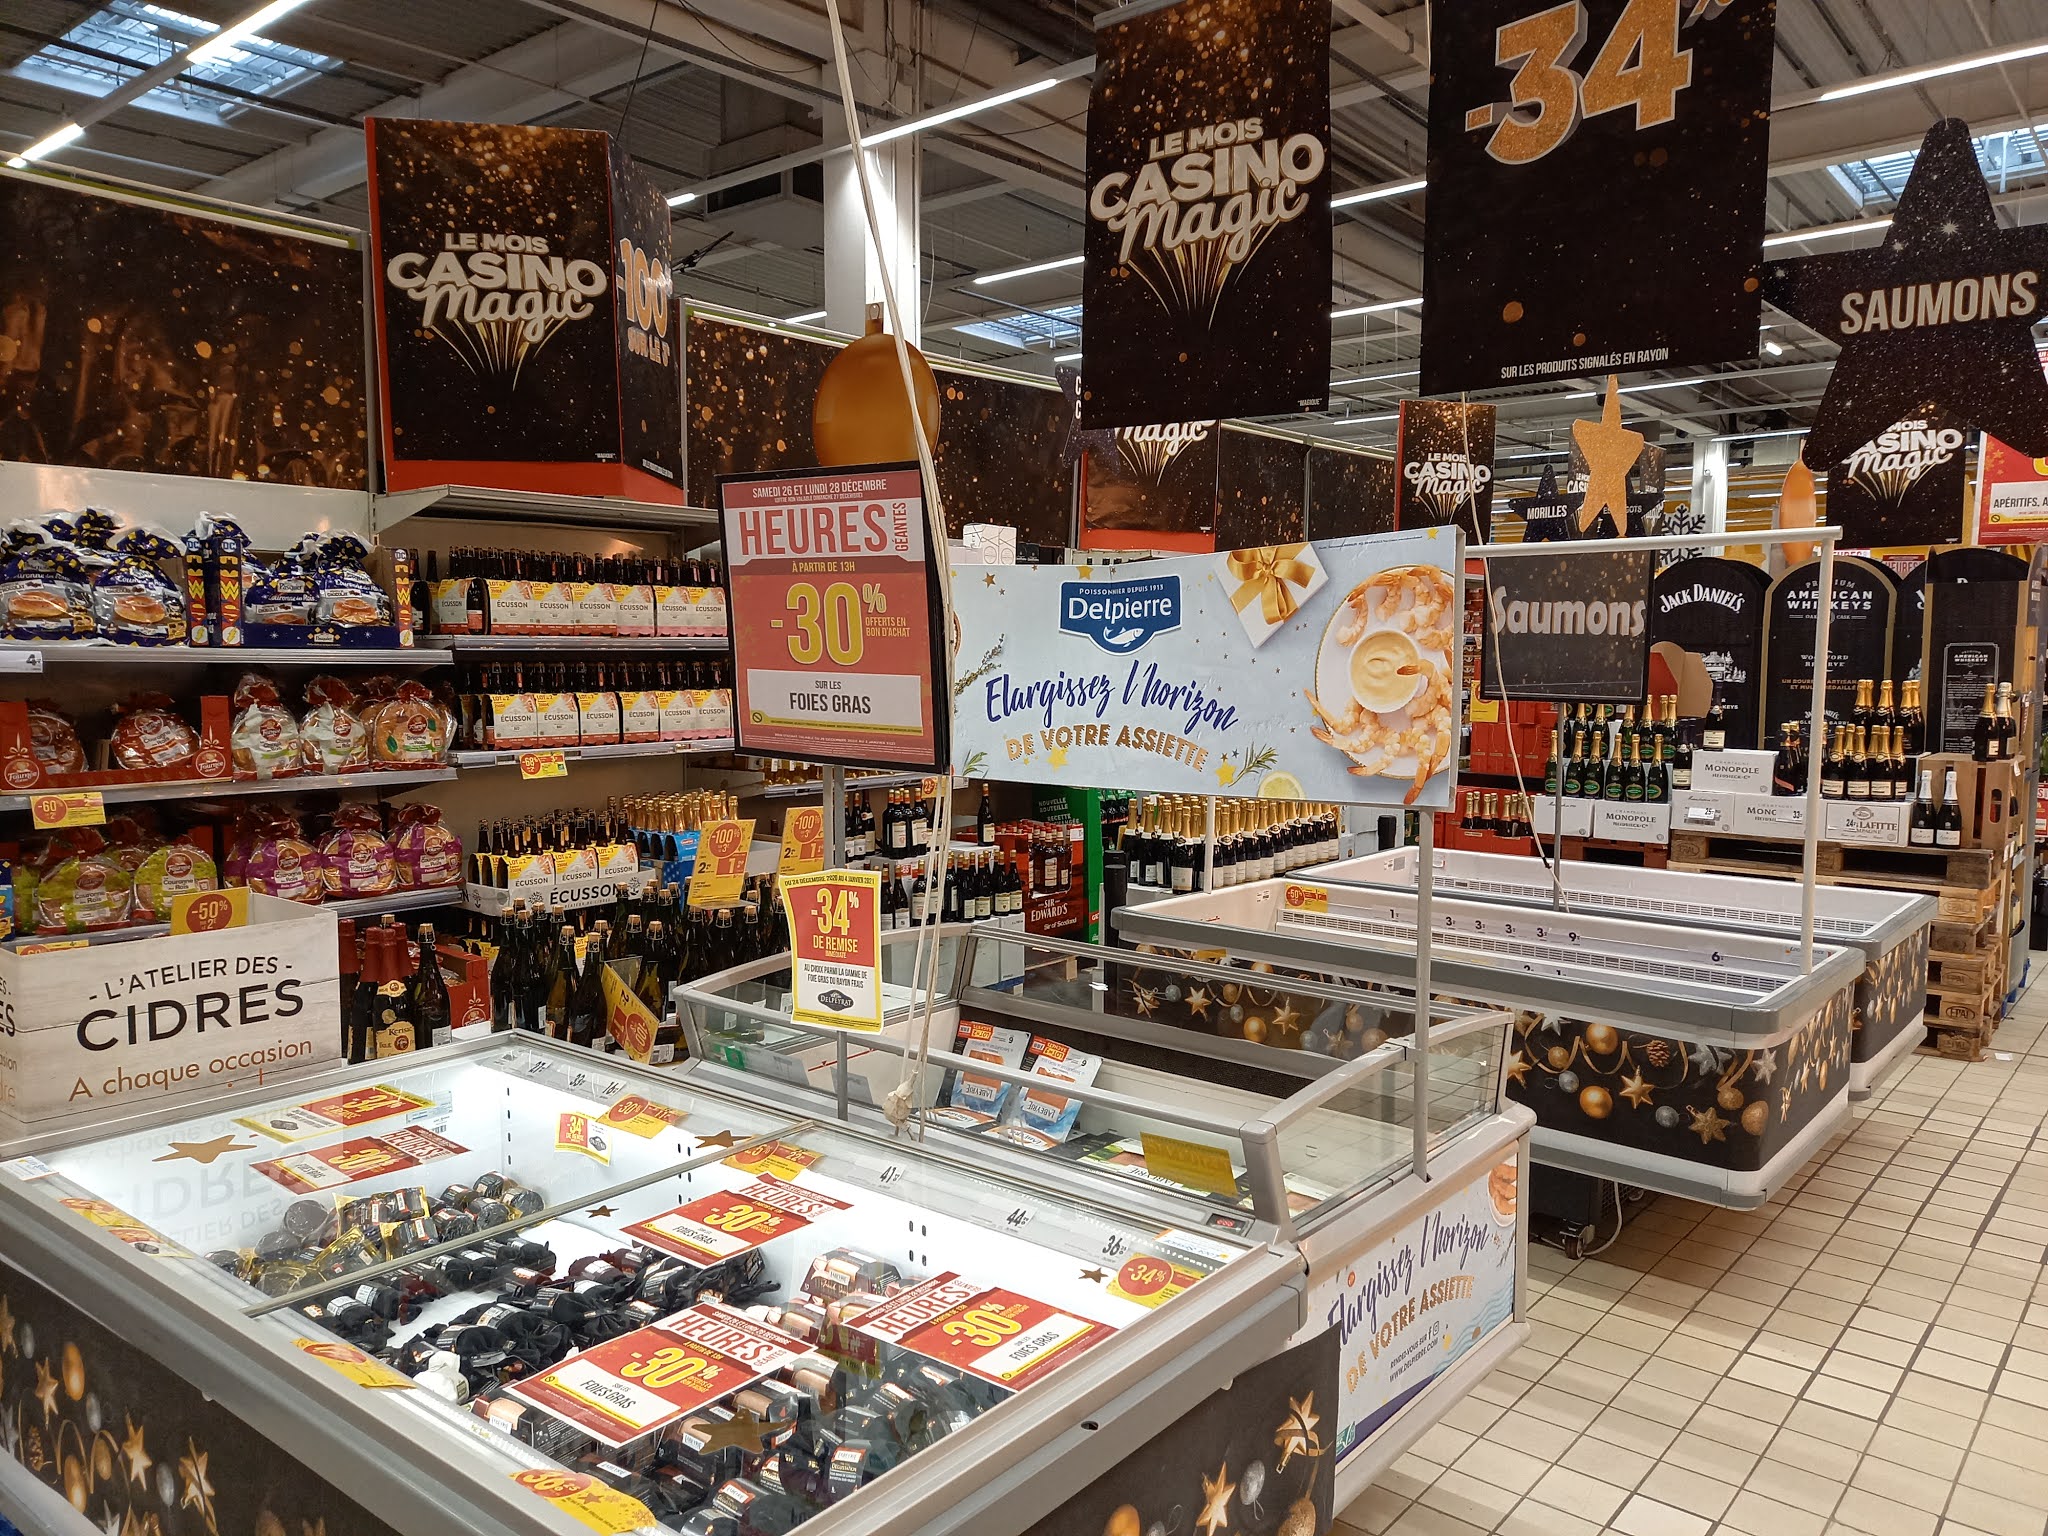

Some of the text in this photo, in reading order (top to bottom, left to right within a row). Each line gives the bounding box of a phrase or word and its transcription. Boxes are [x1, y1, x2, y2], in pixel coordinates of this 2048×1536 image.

[1149, 117, 1264, 160] LE MOIS
[1090, 133, 1326, 220] CASINO
[444, 233, 549, 254] LE MOIS
[387, 252, 607, 297] CASINO
[1840, 271, 2037, 335] SAUMONS
[1501, 347, 1669, 379] SUR LES PRODUITS SIGNALÉS EN RAYON
[1427, 453, 1441, 462] LE
[752, 479, 887, 498] SAMEDI 26 ET LUNDI 28 DÉCEMBRE
[1526, 504, 1568, 520] MORILLES
[739, 503, 888, 557] HEURES
[892, 502, 909, 552] GÉANTES
[792, 561, 855, 573] À PARTIR DE 13H
[1079, 583, 1164, 596] POISSONNIER DEPUIS 1913
[1659, 584, 1746, 614] JACK DANIEL'S
[1787, 590, 1873, 600] AMEICAN
[496, 599, 528, 608] ÉCUSSON
[539, 602, 569, 610] ÉCUSSON
[579, 601, 611, 610] ÉCUSSON
[619, 603, 649, 611] ÉCUSSON
[1068, 597, 1172, 624] Delpierre
[1492, 585, 1645, 637] Saumons
[1787, 601, 1872, 610] WHIKEYS
[770, 581, 888, 667] -30%
[865, 616, 907, 627] OFFERTS EN
[866, 627, 910, 638] BON D'ACHAT
[815, 680, 841, 690] SUR LES
[789, 692, 871, 714] FOIES GRAS
[985, 659, 1239, 736] Elargissez l'horizon
[500, 714, 531, 722] ÉCUSSON
[544, 713, 573, 721] ÉCUSSON
[586, 711, 613, 719] ÉCUSSON
[1005, 724, 1210, 772] DE VOTRE ASSIETTE
[1704, 763, 1760, 775] MONOPOLE
[1605, 813, 1657, 823] MONOPOLE
[1859, 822, 1898, 832] LAFITTE
[562, 872, 592, 882] ÉCUSSON
[604, 865, 633, 875] ÉCUSSON
[515, 877, 549, 887] ÉCUSSON
[191, 899, 228, 920] -50%
[811, 888, 859, 936] -34%
[813, 935, 859, 953] DE REMISE
[105, 956, 278, 1000] L'ATELIER DES
[77, 979, 304, 1052] CIDRES
[68, 1039, 312, 1102] A chaque occasion
[738, 1183, 822, 1215] HEURES
[703, 1204, 785, 1233] -30%
[1126, 1263, 1167, 1285] -34%
[870, 1286, 972, 1336] HEURES
[942, 1301, 1022, 1347] -30%
[1345, 1275, 1475, 1395] DE VOTRE ASSIETTE
[668, 1313, 773, 1362] HEURES
[1008, 1331, 1060, 1362] FOIES GRAS
[620, 1347, 724, 1389] -30%
[579, 1380, 639, 1410] FOIES GRAS
